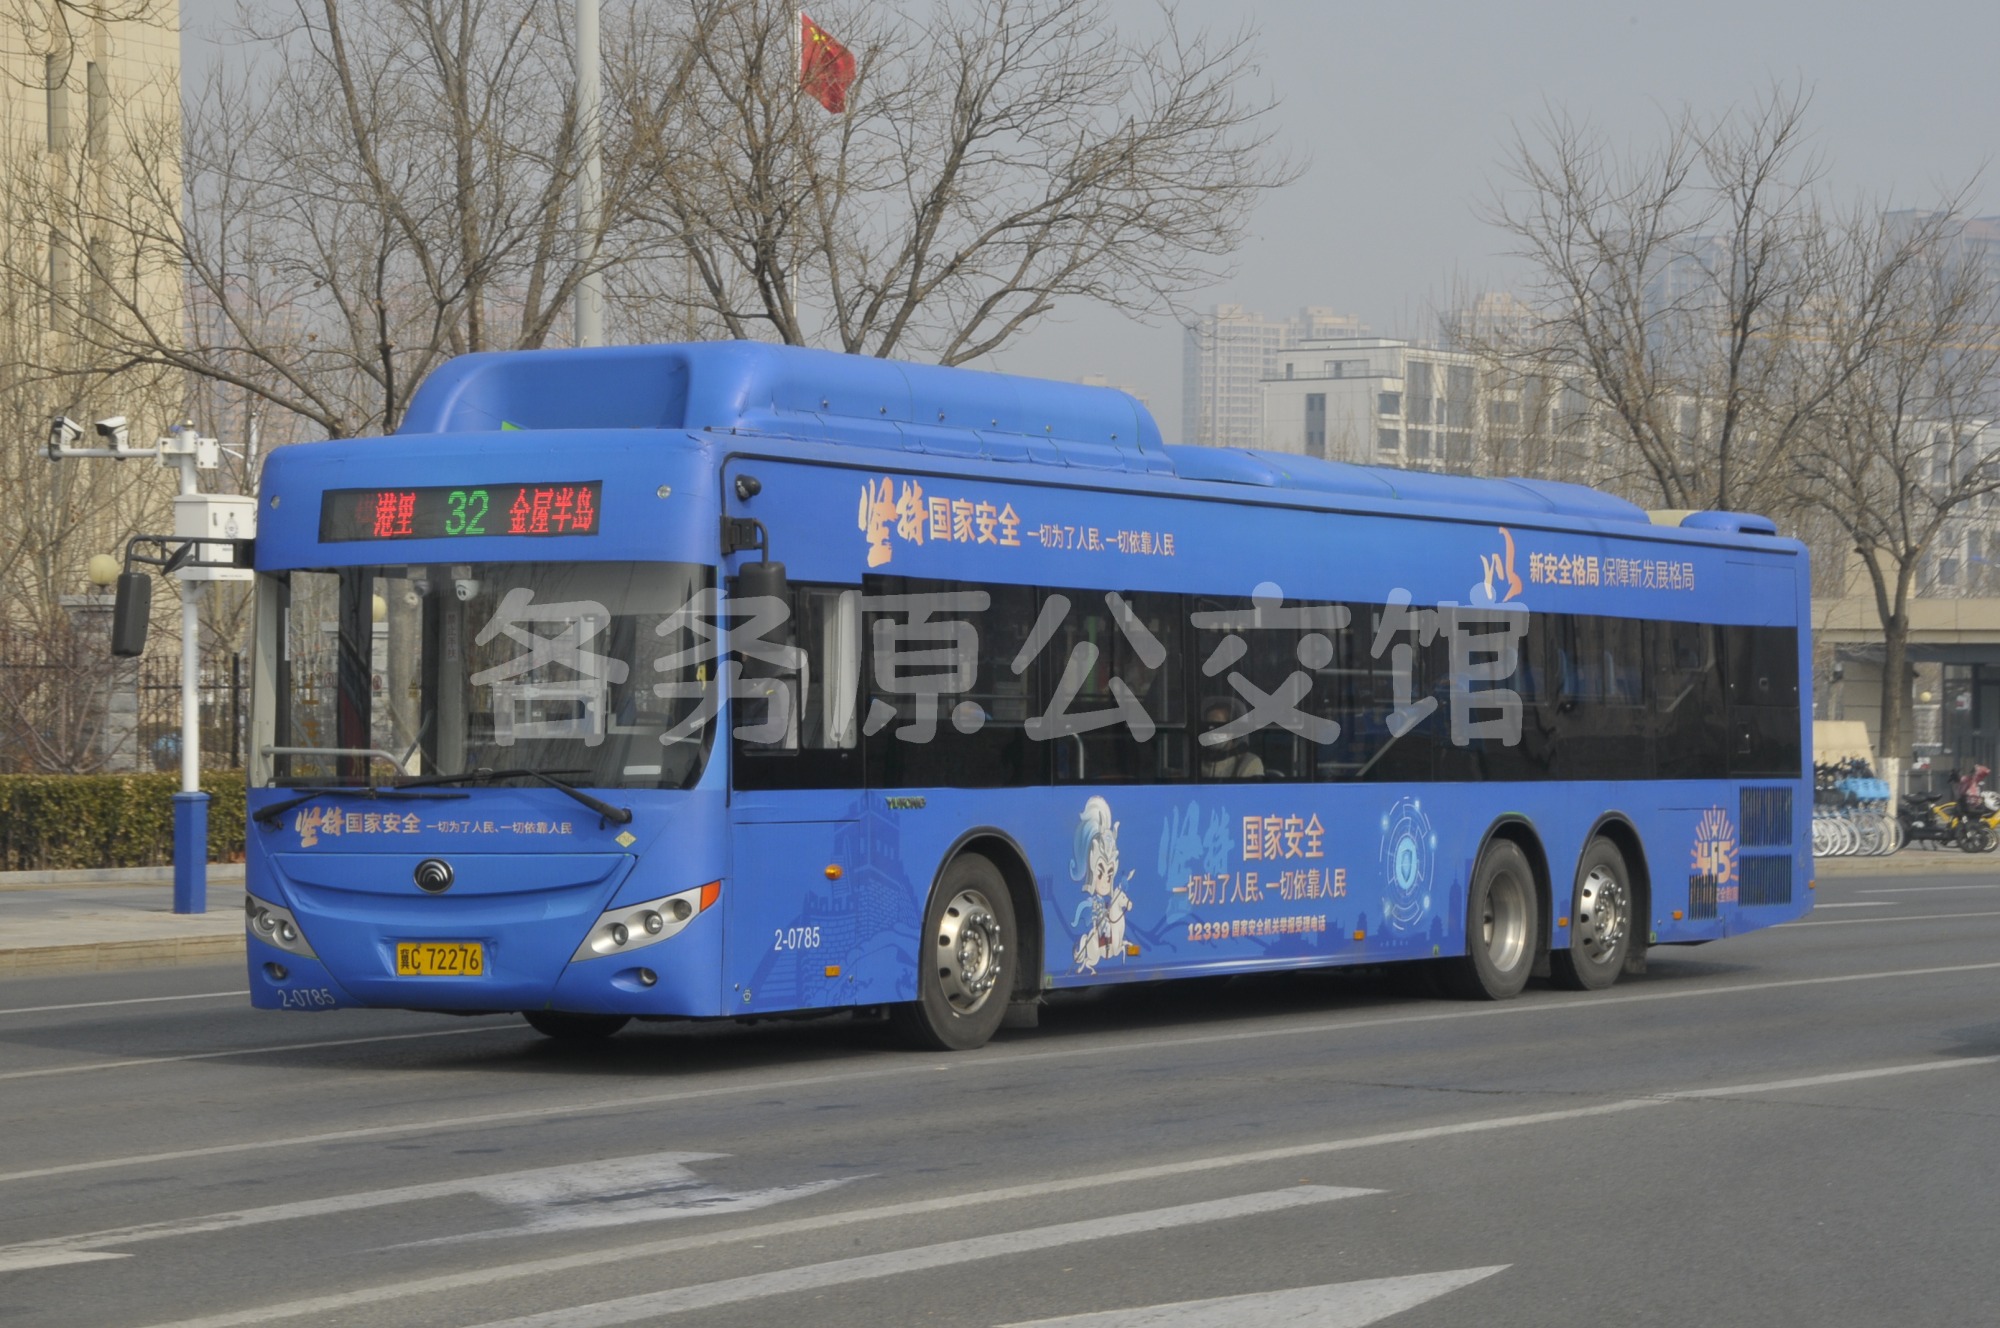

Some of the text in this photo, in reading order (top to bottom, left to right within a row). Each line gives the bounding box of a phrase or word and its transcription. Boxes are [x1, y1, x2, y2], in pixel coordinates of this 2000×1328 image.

[445, 490, 489, 535] 32
[507, 487, 594, 534] 金屋半岛
[1027, 524, 1176, 557] 一切为了人民、一切依靠人民
[1602, 556, 1695, 591] 保障新发展格局
[426, 821, 573, 835] 一切为了人民、一切依靠人民
[1171, 868, 1347, 905] 一切为了人民、一切依靠人民
[774, 926, 820, 951] 2-0785
[1187, 921, 1230, 941] 12339
[277, 988, 335, 1008] 2-0785
